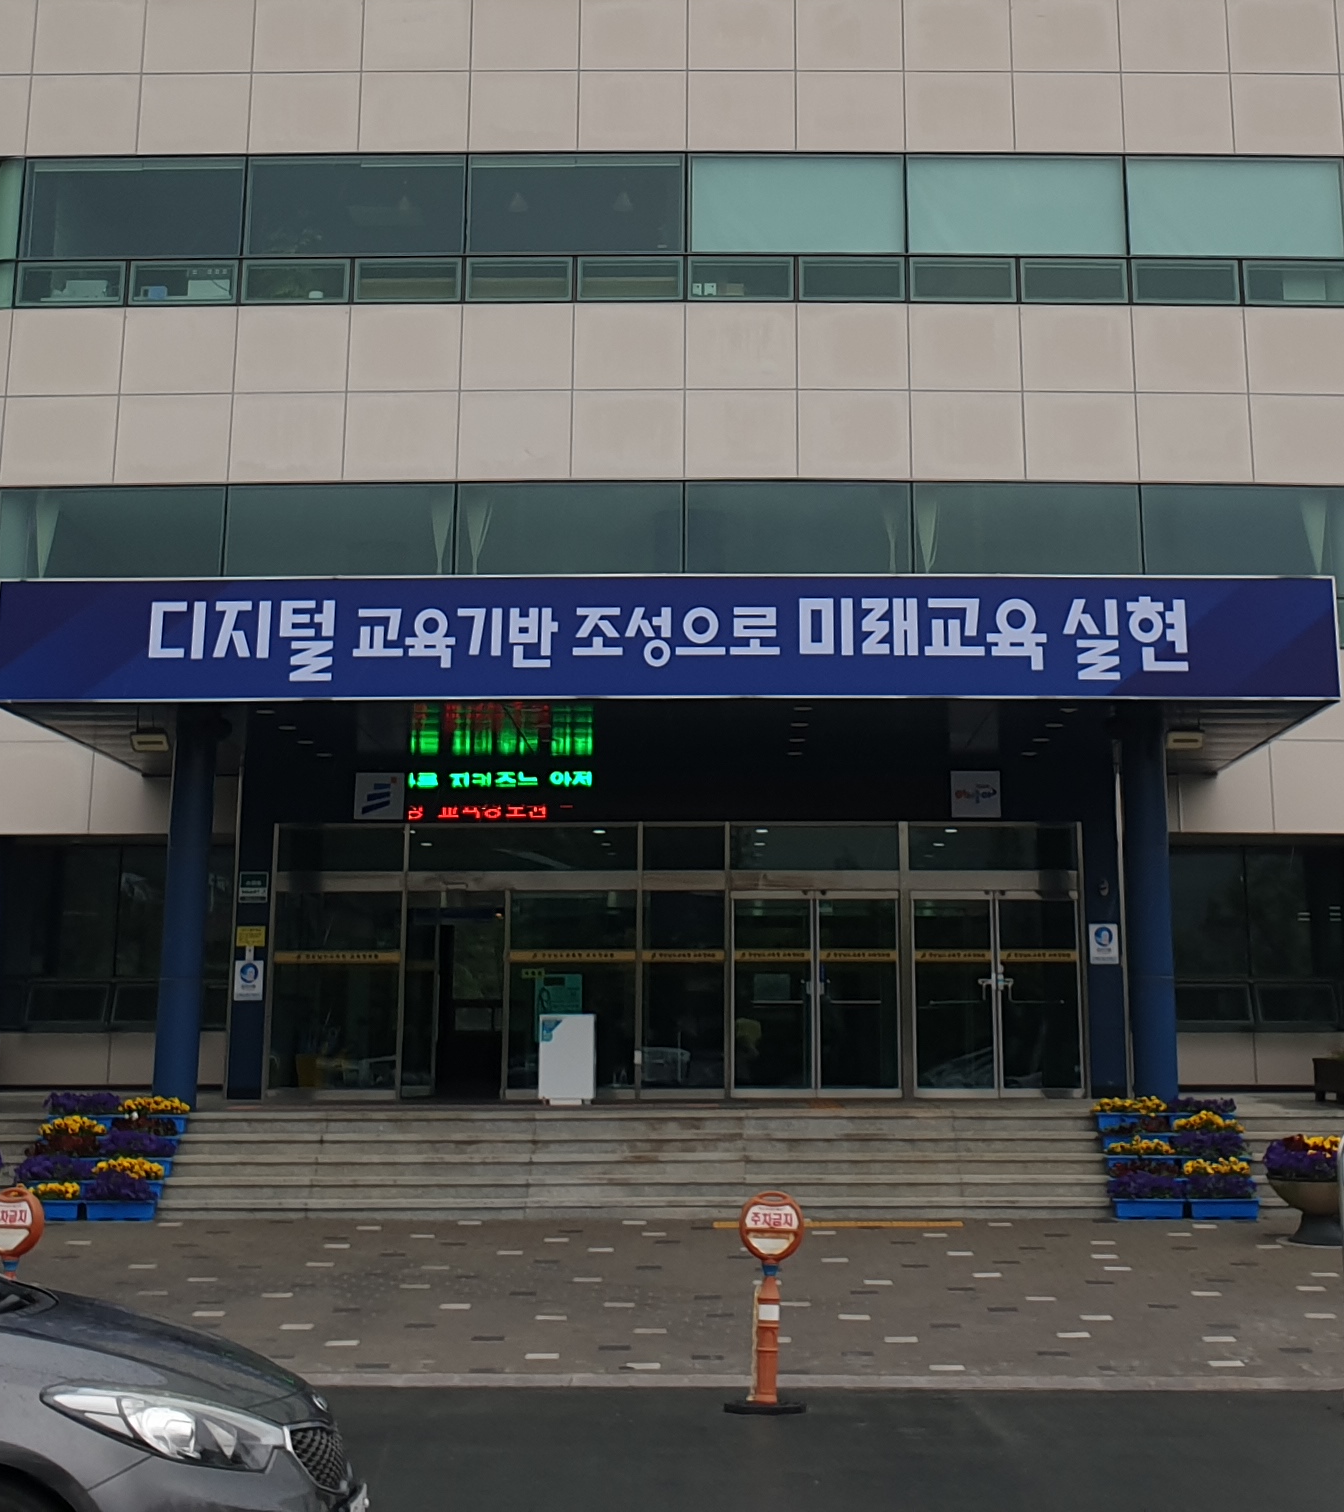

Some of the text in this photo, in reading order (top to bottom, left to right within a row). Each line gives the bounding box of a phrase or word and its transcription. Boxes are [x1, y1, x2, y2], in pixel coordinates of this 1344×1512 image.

[148, 596, 1189, 682] 디지털 교육기반 조성으로 미래교육 실현
[751, 1211, 793, 1228] 주차금지
